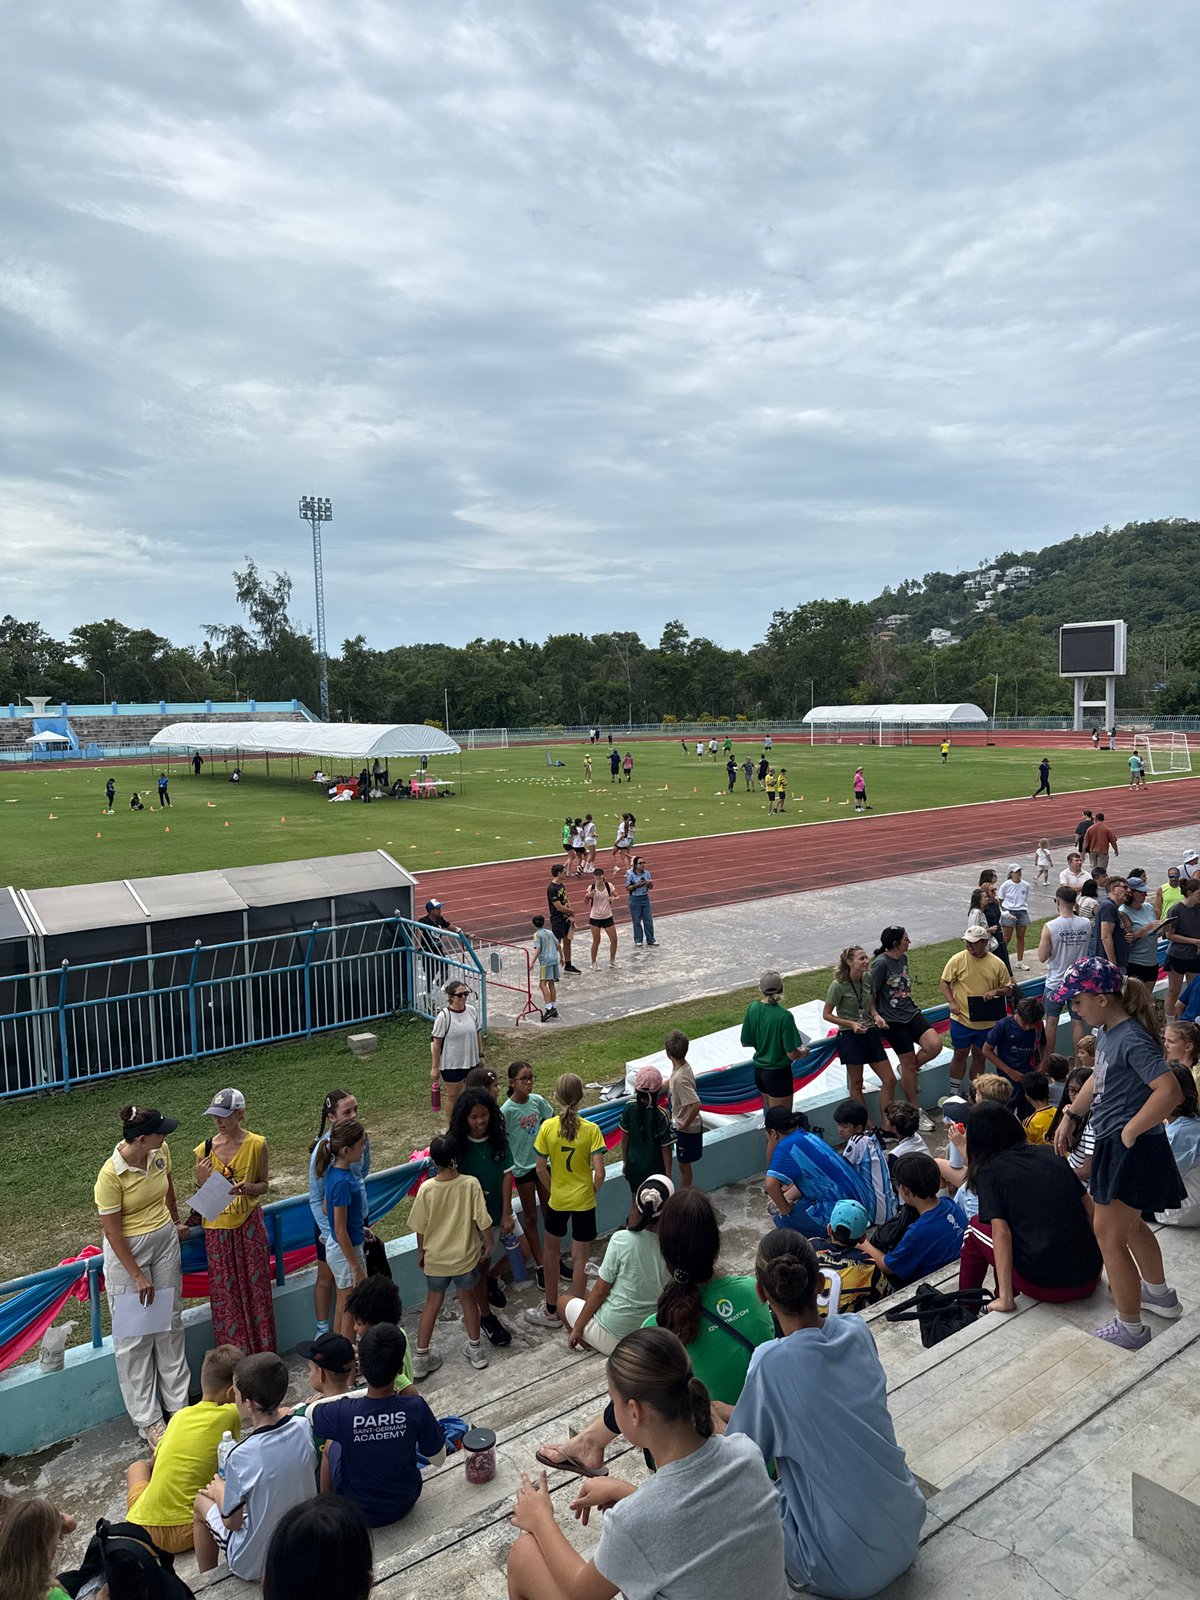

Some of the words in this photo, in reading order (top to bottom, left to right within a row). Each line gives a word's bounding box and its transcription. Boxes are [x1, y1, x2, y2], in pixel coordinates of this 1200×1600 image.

[561, 1146, 576, 1173] 7
[708, 1308, 750, 1332] OVWATCH
[353, 1411, 407, 1428] PARIS
[353, 1423, 407, 1435] SAINT-GERMAIN
[353, 1429, 406, 1442] ACADEMY
